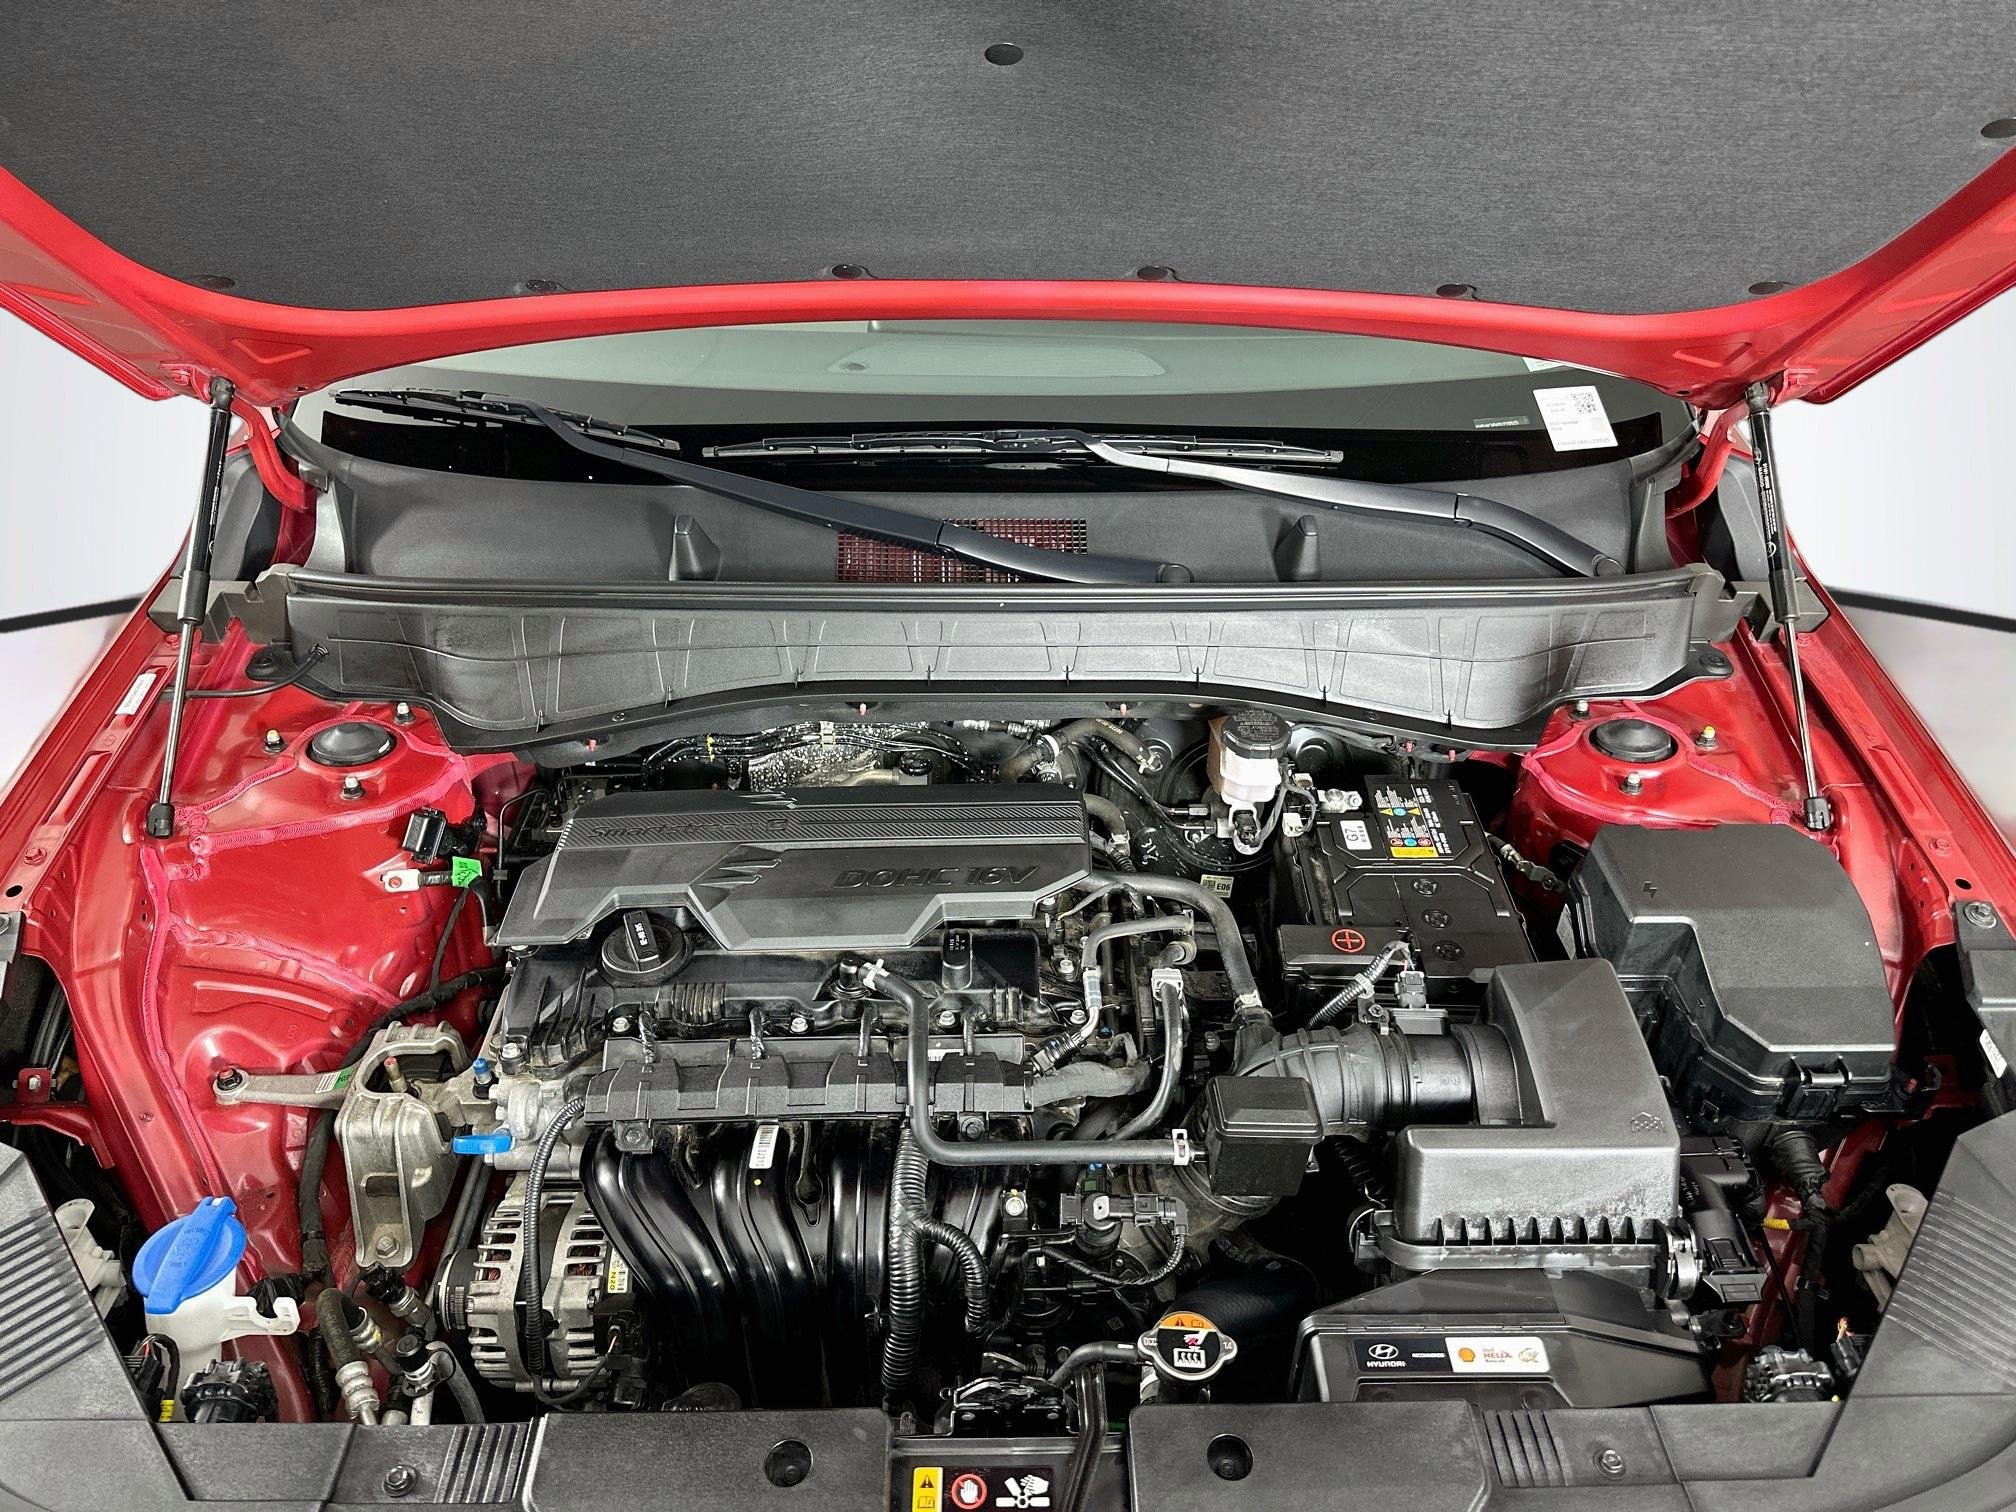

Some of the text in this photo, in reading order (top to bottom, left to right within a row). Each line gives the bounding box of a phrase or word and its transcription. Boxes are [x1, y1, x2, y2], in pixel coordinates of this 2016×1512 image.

[832, 865, 1040, 889] DOHC 16V
[1216, 883, 1231, 891] E06
[1366, 1360, 1407, 1368] HYUNDAI
